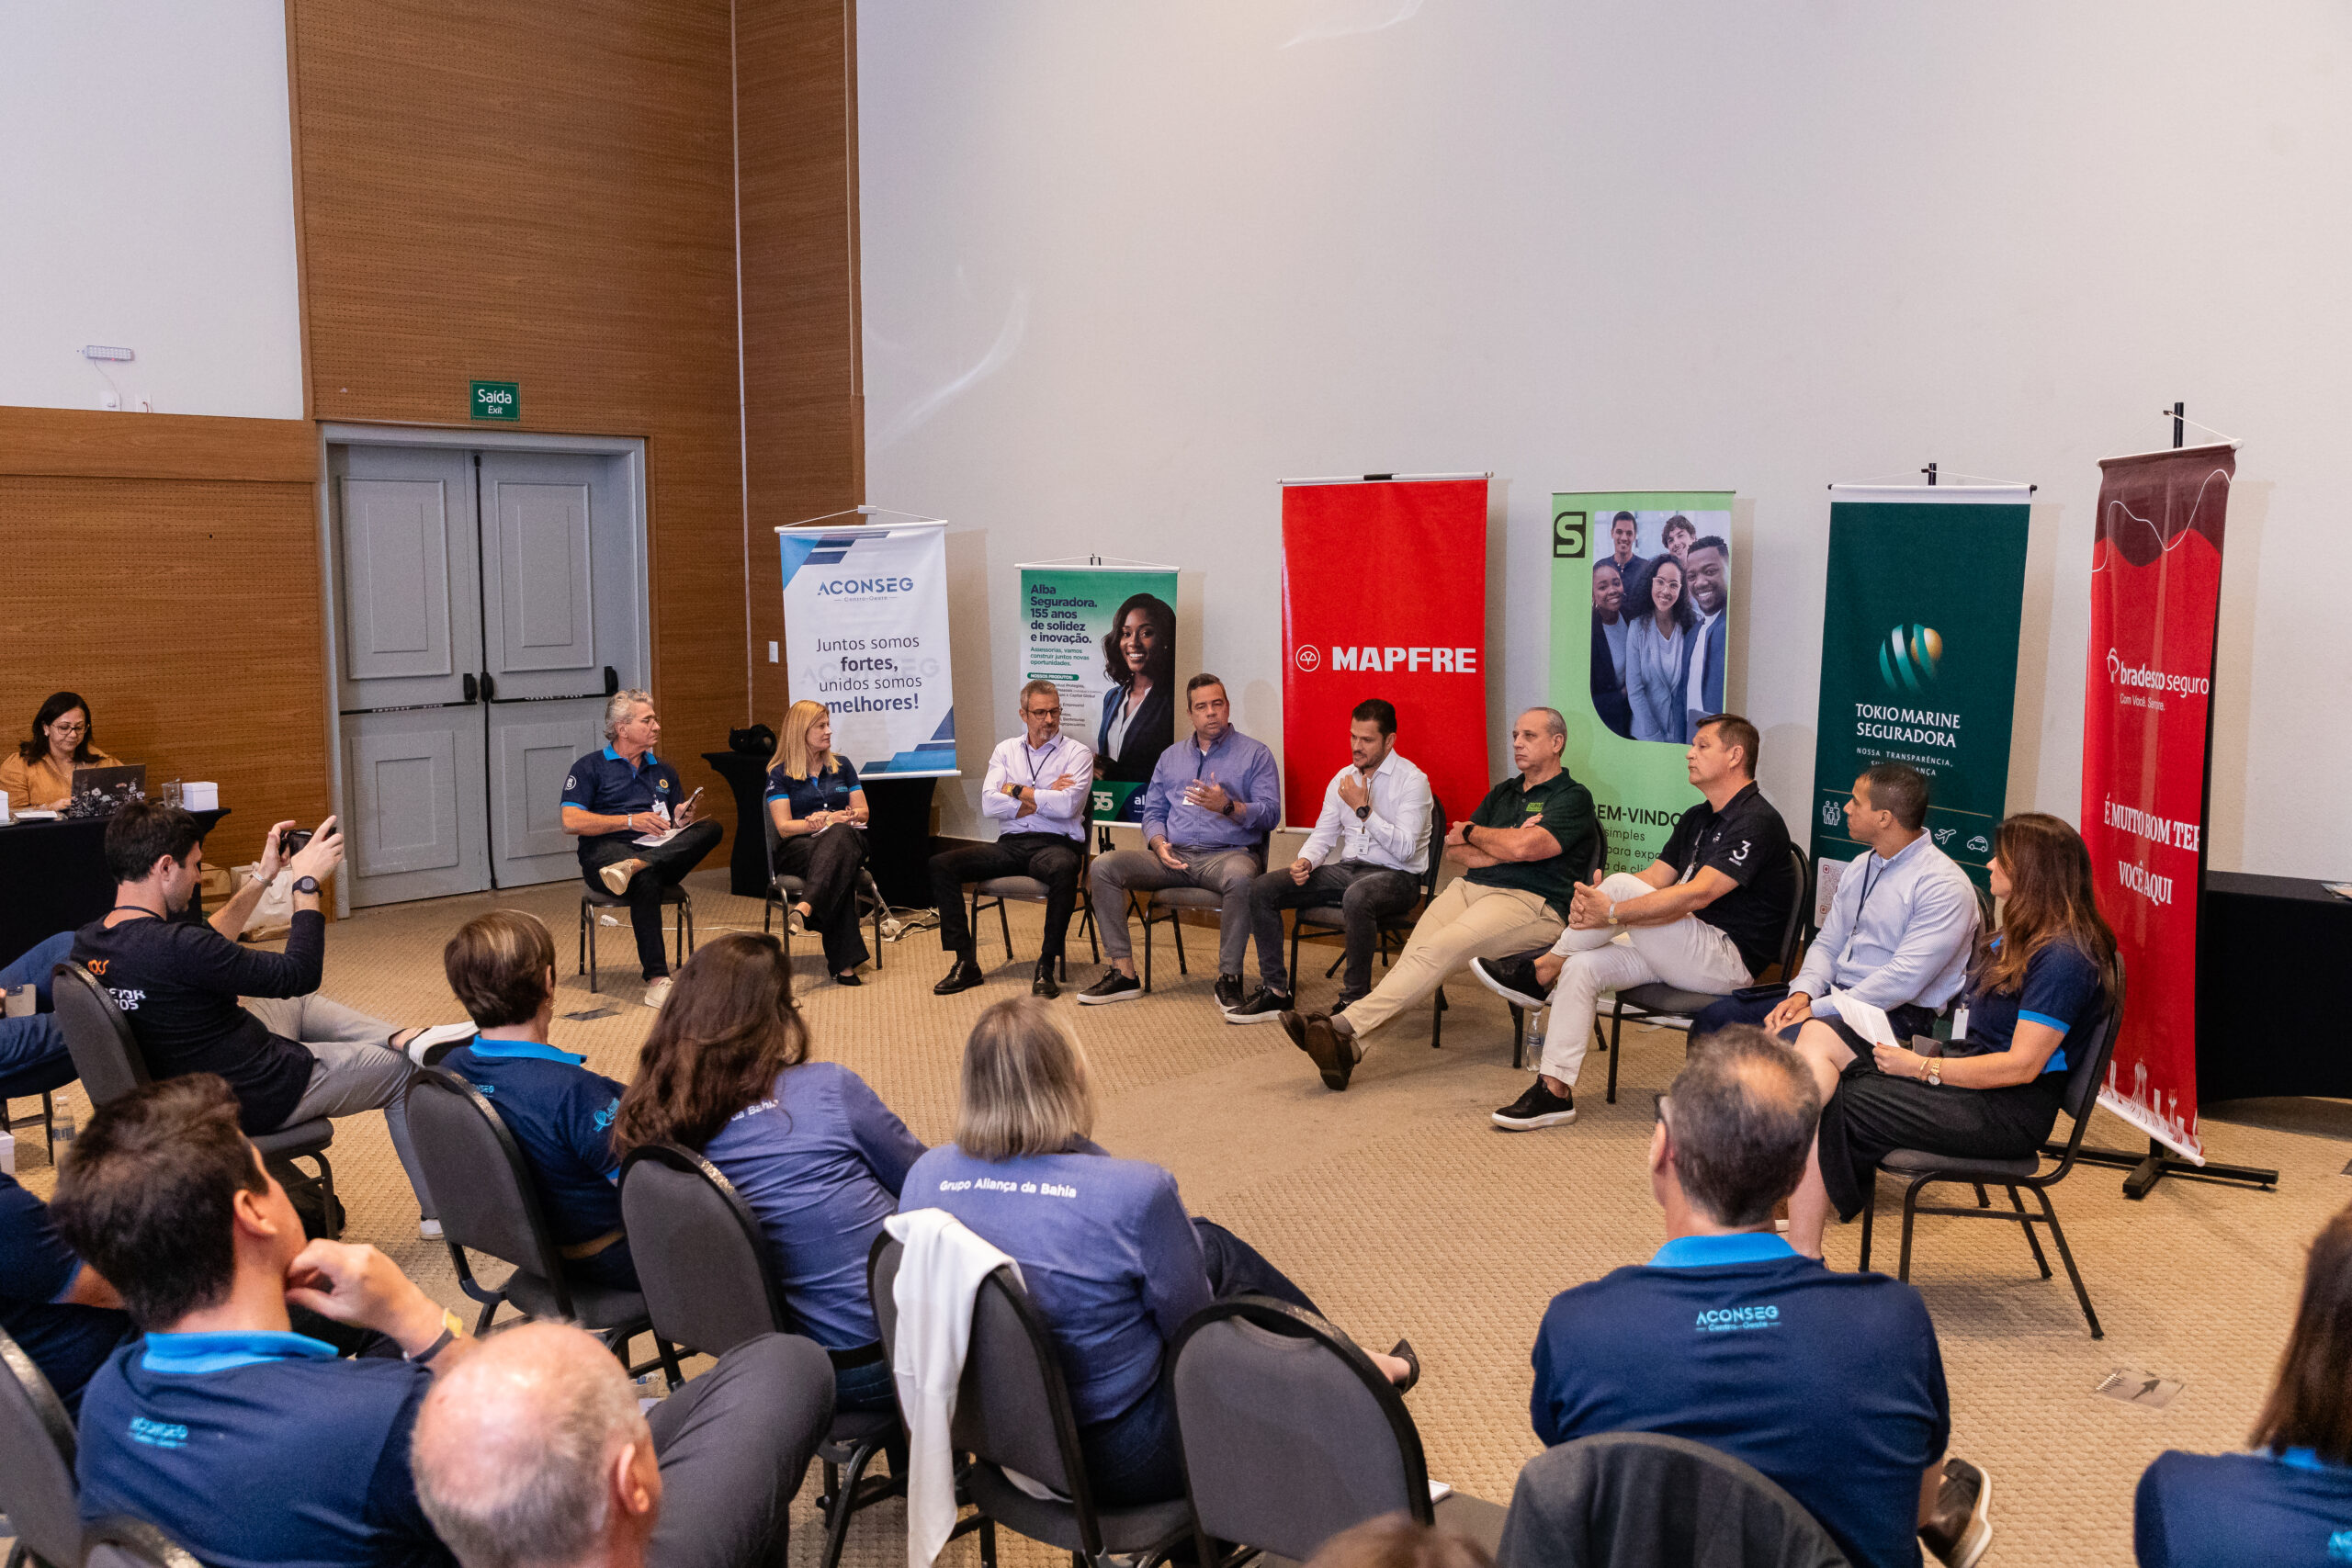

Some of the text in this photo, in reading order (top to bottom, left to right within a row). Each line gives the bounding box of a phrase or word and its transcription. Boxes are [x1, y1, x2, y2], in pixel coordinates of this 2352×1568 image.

[478, 389, 512, 404] Saída
[488, 405, 503, 414] Exit
[818, 577, 914, 595] ACONSEG
[1030, 584, 1057, 594] Alba
[1030, 596, 1097, 607] Seguradora.
[1030, 608, 1078, 619] 155 anos
[1030, 620, 1086, 631] de solidez
[816, 637, 920, 652] Juntos somos
[1030, 632, 1091, 645] e inovação.
[841, 656, 899, 672] fortes,
[1332, 646, 1476, 673] MAPFRE
[819, 676, 922, 692] unidos somos
[2120, 660, 2165, 691] bradesco
[825, 693, 920, 714] melhores!
[2120, 693, 2132, 705] Com
[2132, 694, 2147, 707] Você.
[1855, 703, 1961, 728] TOKIO MARINE
[1856, 722, 1956, 748] SEGURADORA
[1856, 747, 1881, 757] NOSSA
[1598, 804, 1683, 827] EM-VINDO
[2103, 792, 2110, 825] É
[2110, 803, 2144, 837] MUITO
[2144, 813, 2171, 845] BOM
[1733, 840, 1751, 861] 3
[2118, 859, 2173, 907] VOCÊ AQUI
[939, 1178, 1077, 1198] Grupo Aliança da Bahia
[1696, 1305, 1779, 1325] ACONSEG
